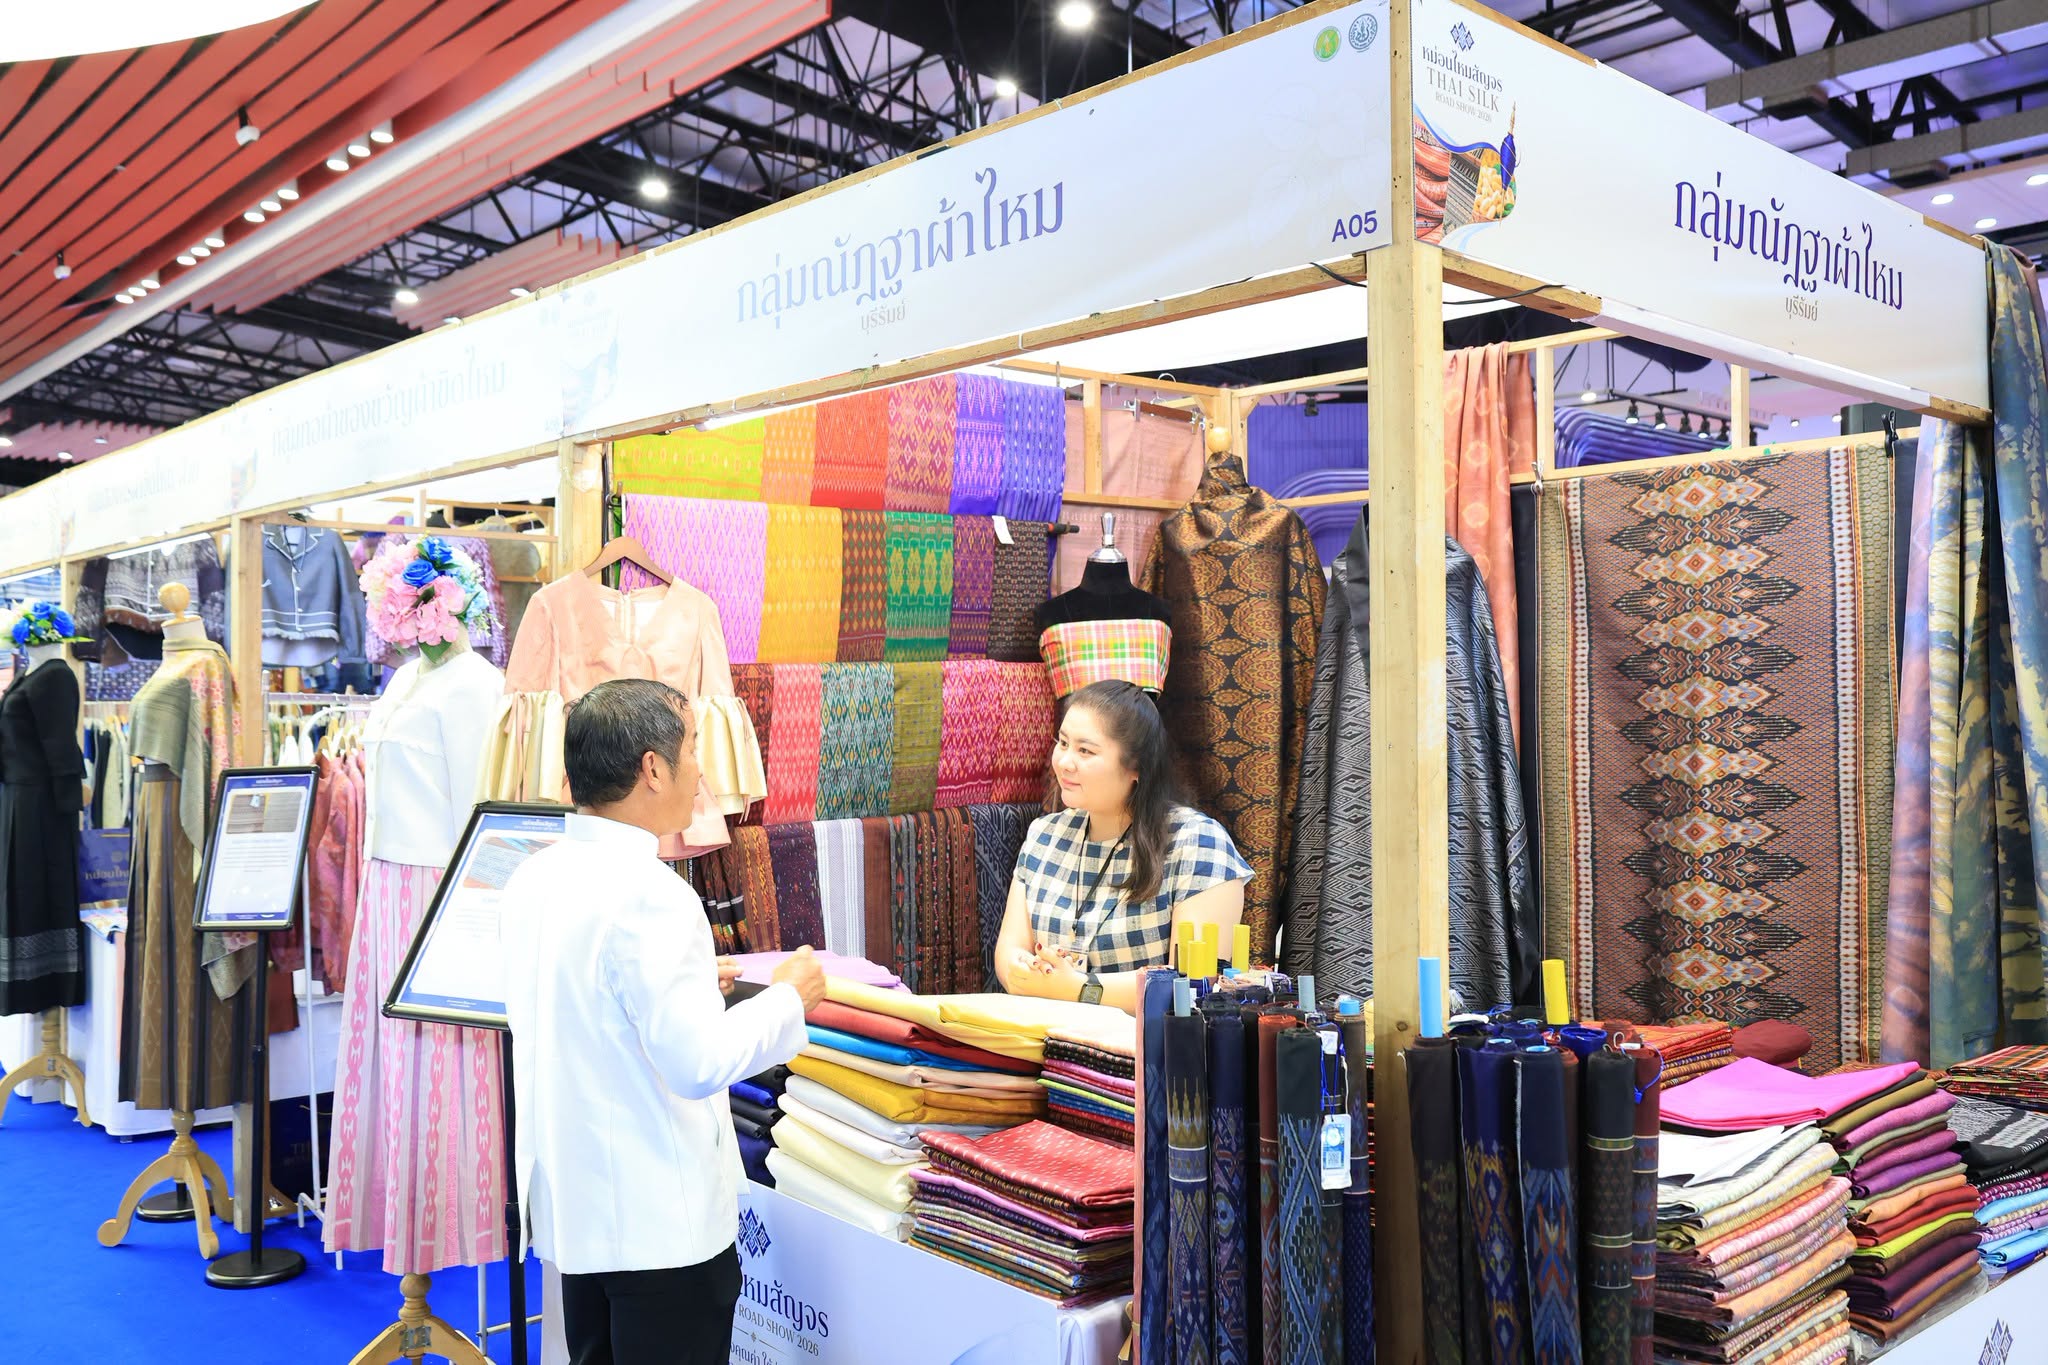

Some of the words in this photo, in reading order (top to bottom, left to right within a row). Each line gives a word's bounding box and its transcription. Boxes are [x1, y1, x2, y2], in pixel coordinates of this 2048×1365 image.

[1421, 45, 1503, 92] หม่อนไหมสัญจร
[1427, 66, 1463, 97] THAI
[1468, 85, 1500, 113] SILK
[1435, 92, 1455, 108] ROAD
[1456, 101, 1476, 116] SHOW
[1331, 209, 1378, 242] A05
[860, 299, 906, 335] บุรีรัมย์
[1785, 295, 1819, 322] บุรีรัมย์
[738, 1303, 765, 1327] ROAD
[766, 1317, 796, 1344] SHOW
[797, 1334, 819, 1357] 2026
